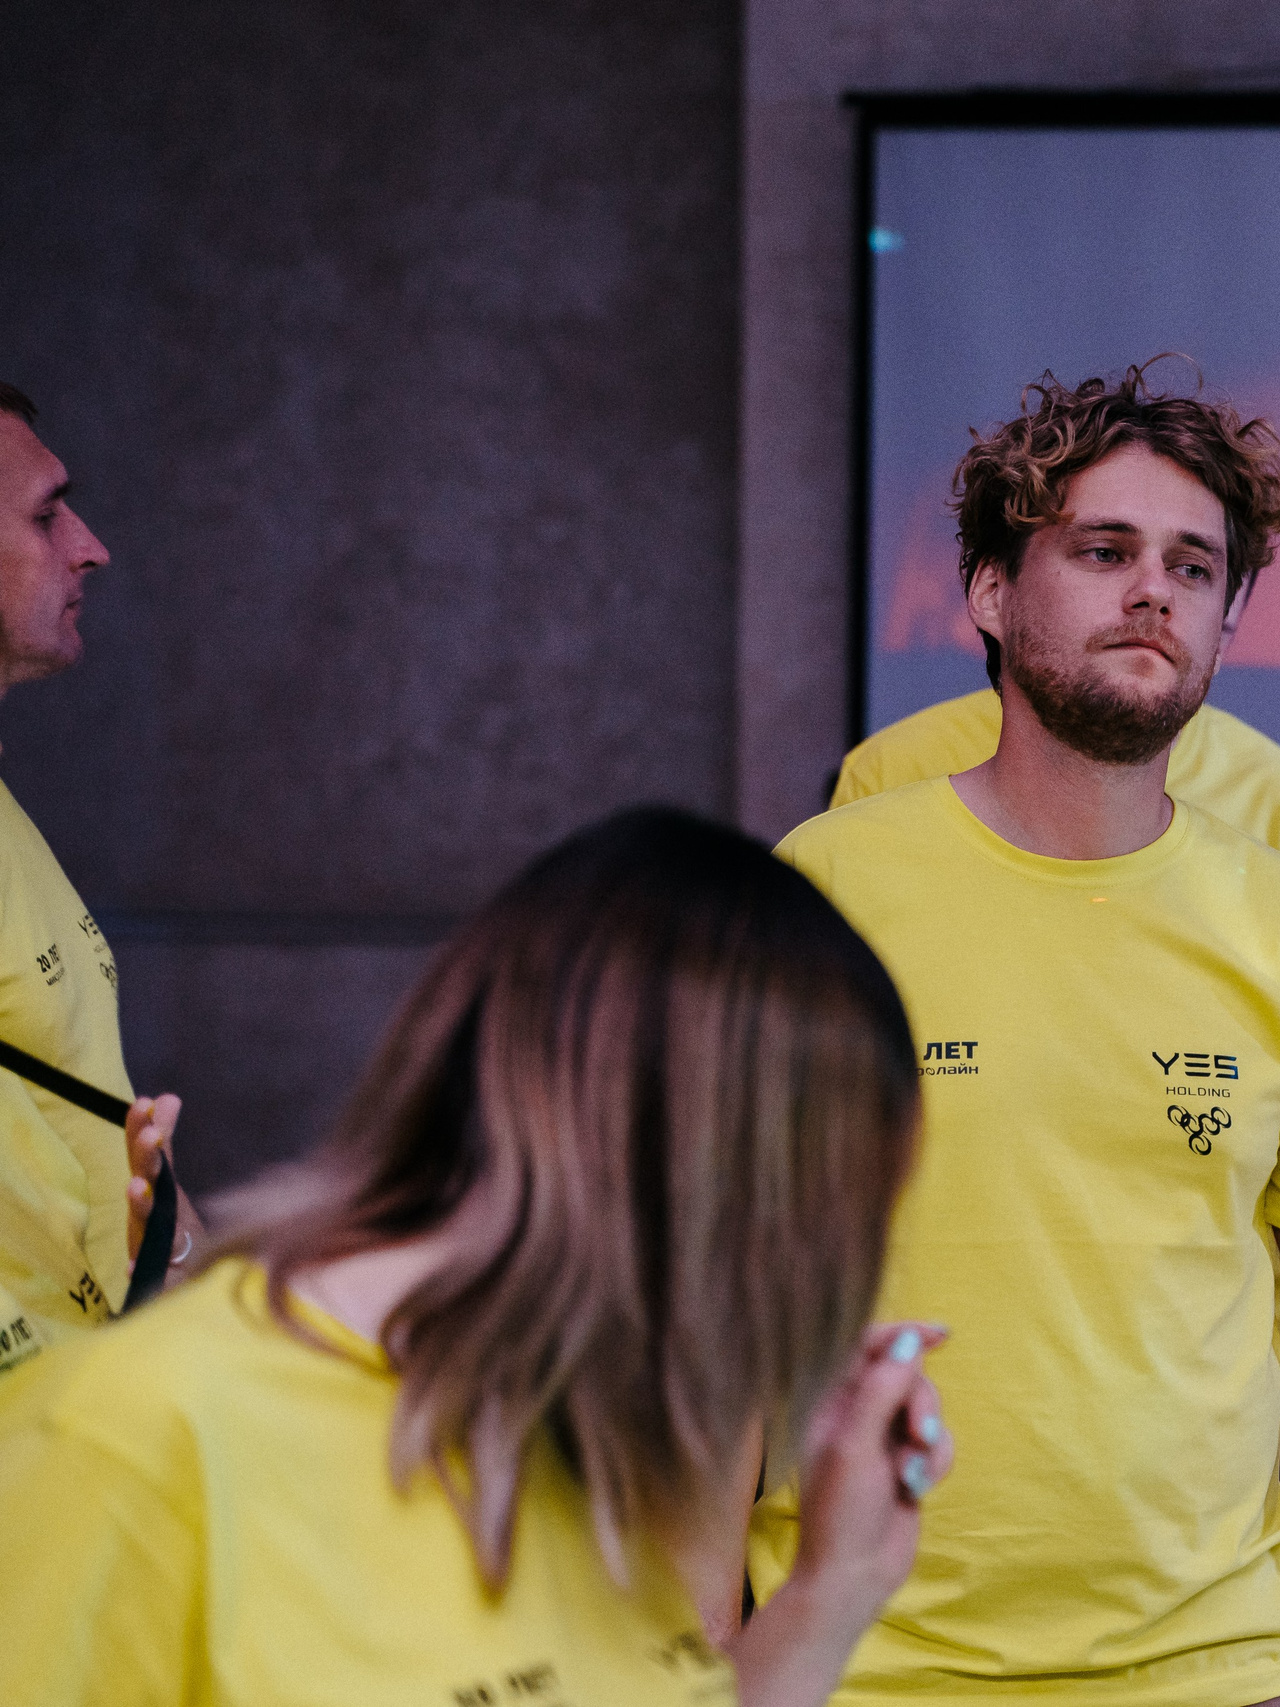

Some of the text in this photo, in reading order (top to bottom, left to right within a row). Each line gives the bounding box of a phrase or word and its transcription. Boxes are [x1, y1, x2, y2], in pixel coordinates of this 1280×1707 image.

[36, 954, 52, 974] 20
[923, 1041, 979, 1061] ЛЕТ
[1152, 1051, 1239, 1080] YES
[1166, 1086, 1231, 1098] HOLDING
